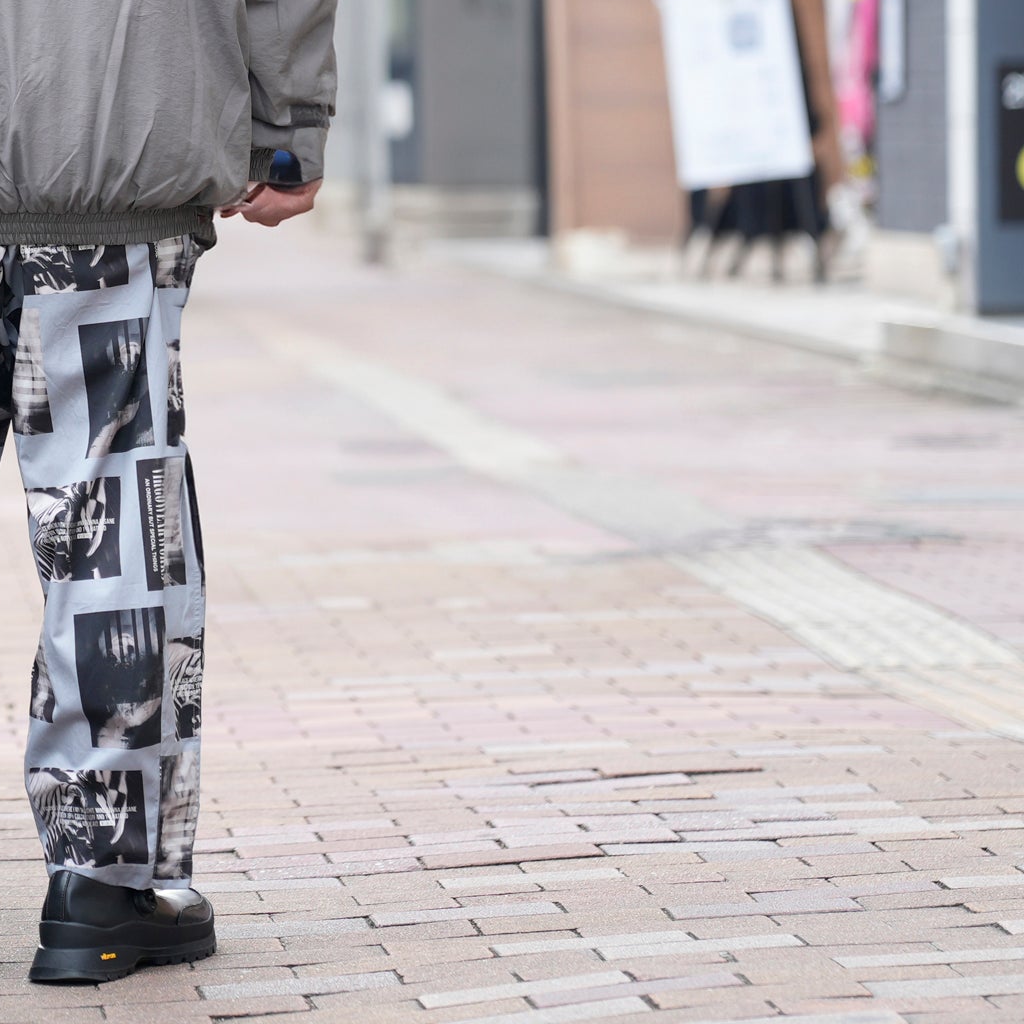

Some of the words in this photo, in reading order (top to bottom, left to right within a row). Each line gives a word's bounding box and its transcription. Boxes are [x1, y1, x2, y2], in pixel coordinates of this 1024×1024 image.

[144, 478, 151, 487] AN
[145, 487, 153, 515] ORDINARY
[149, 528, 157, 551] SPECIAL
